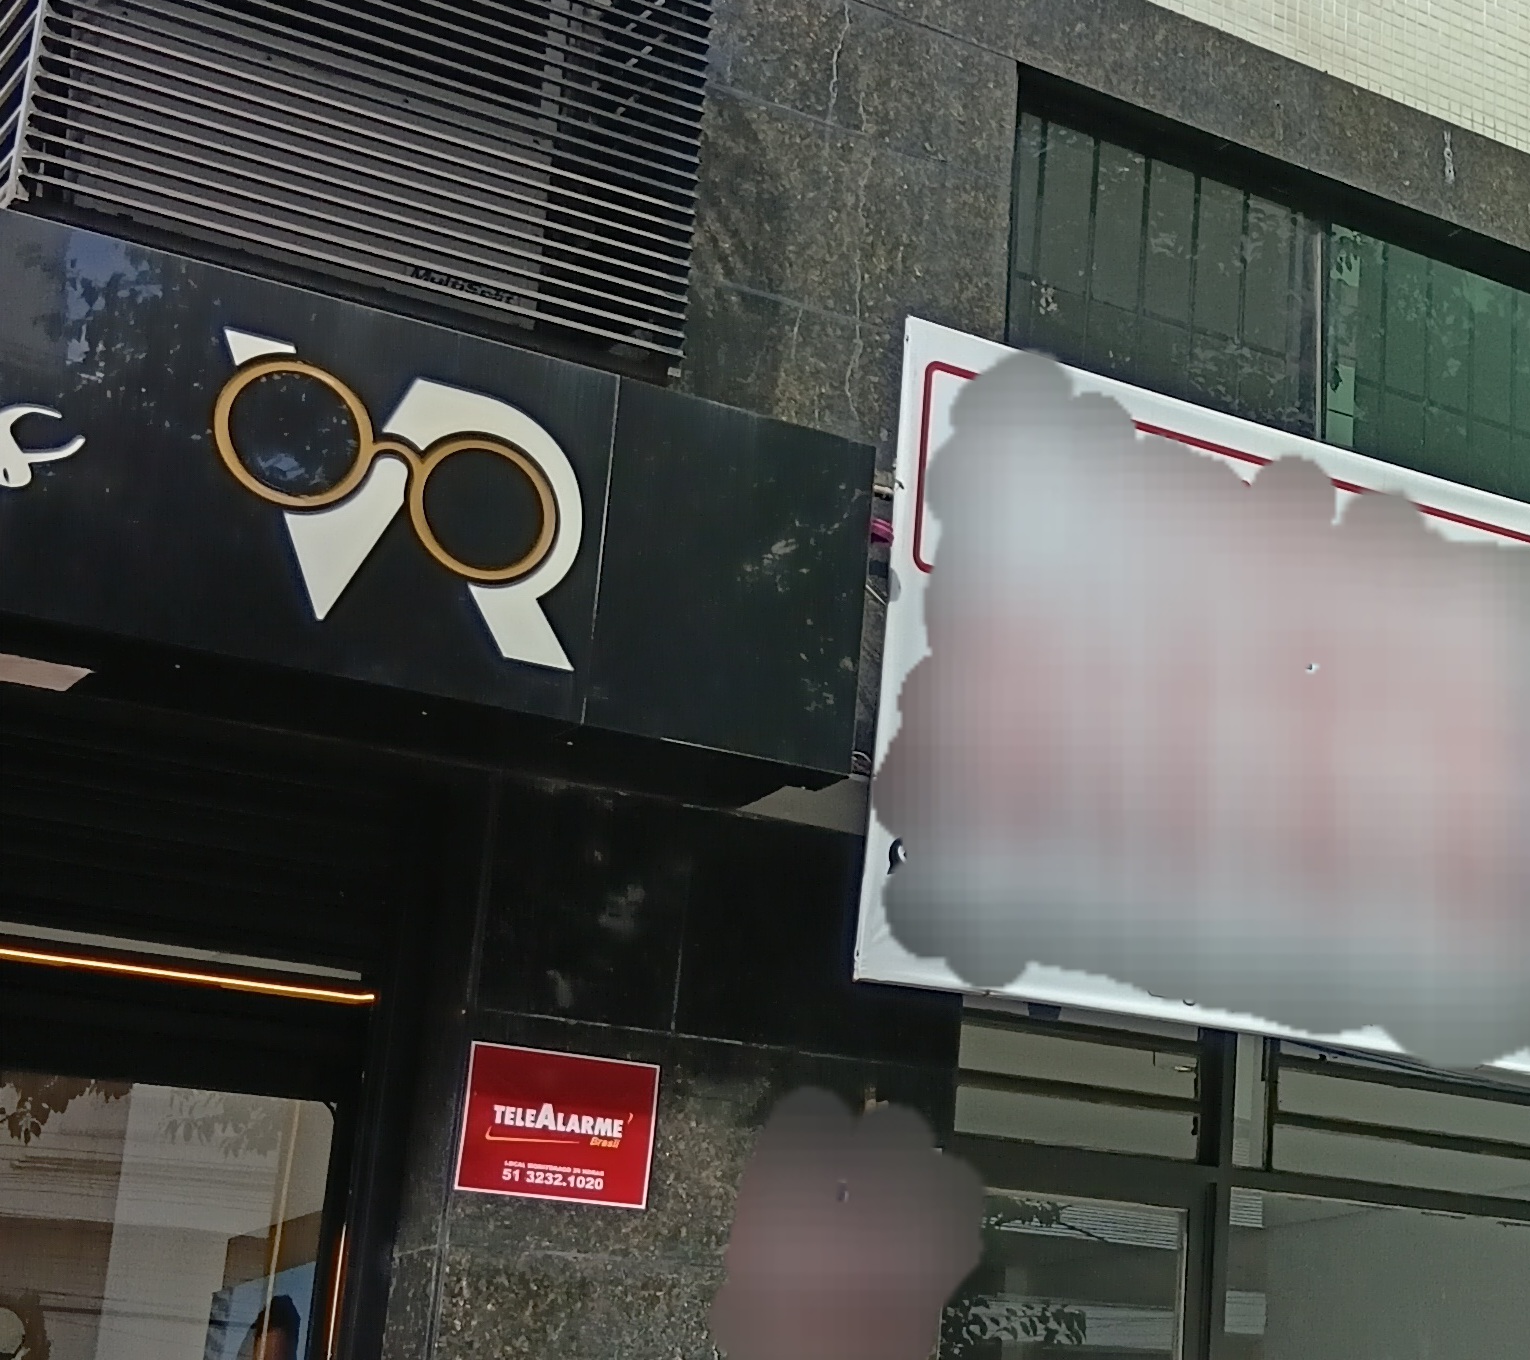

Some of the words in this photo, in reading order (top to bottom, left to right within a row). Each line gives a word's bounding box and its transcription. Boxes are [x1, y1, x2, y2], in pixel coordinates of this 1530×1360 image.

[590, 1137, 620, 1148] Brasil
[502, 1169, 520, 1181] 51
[525, 1171, 604, 1190] 3232.1020
